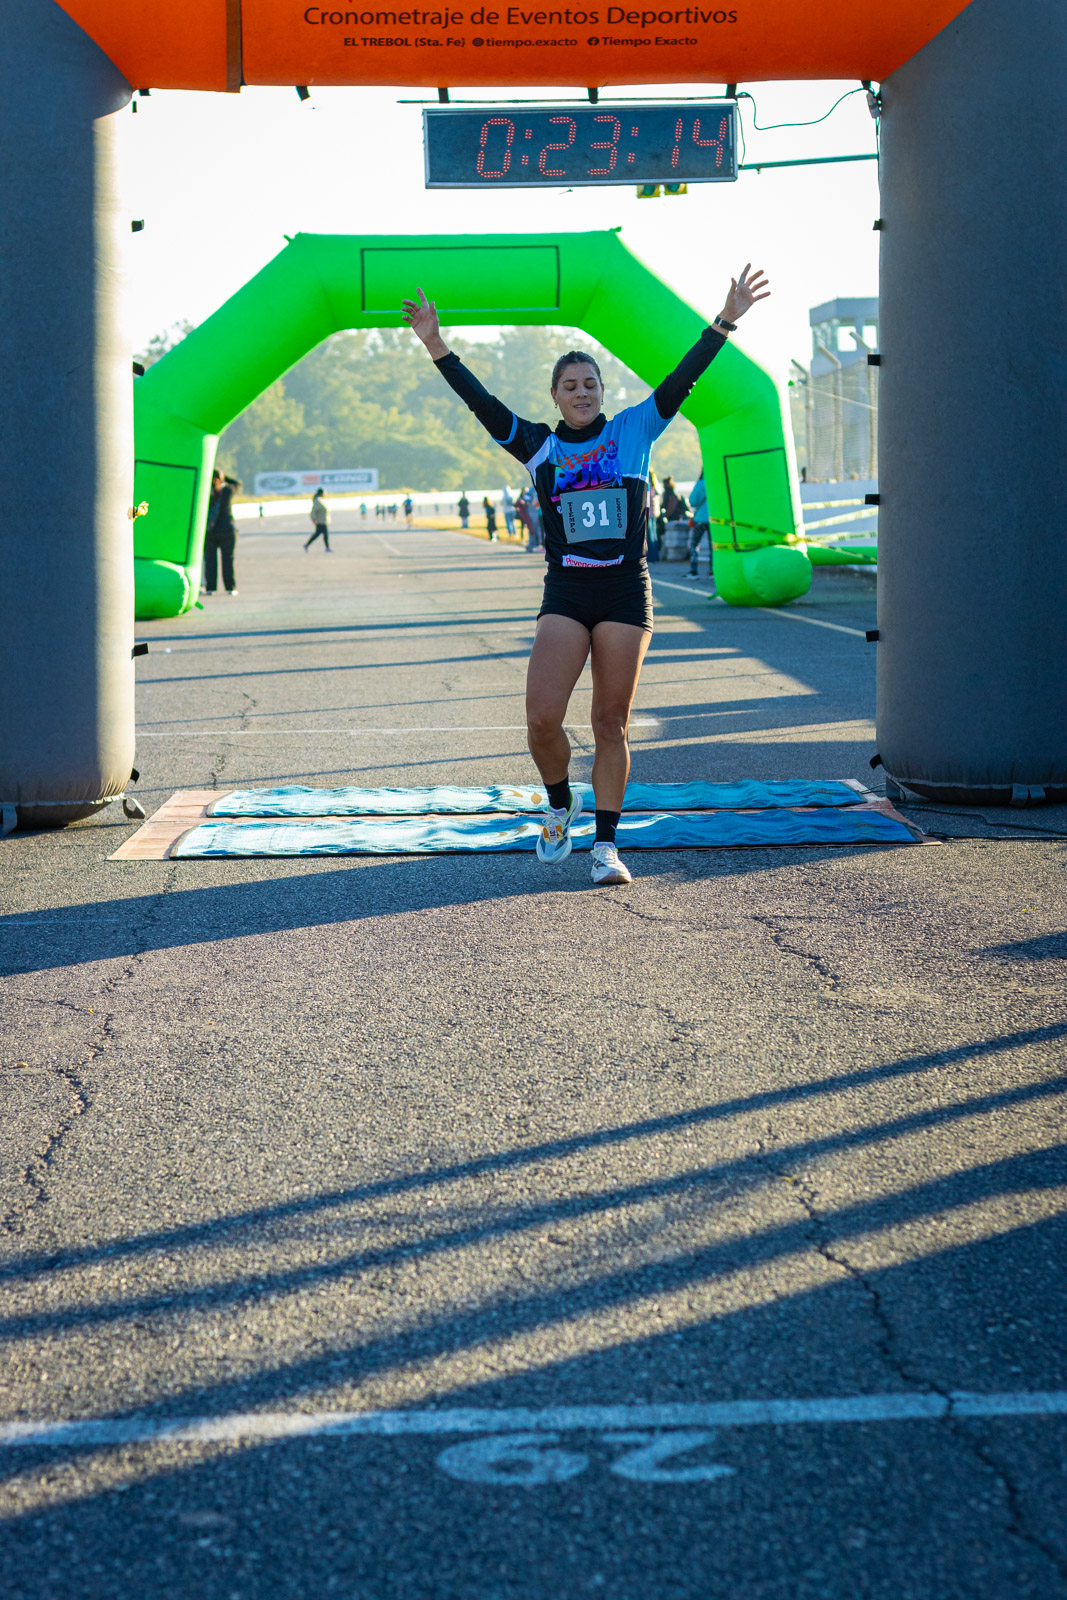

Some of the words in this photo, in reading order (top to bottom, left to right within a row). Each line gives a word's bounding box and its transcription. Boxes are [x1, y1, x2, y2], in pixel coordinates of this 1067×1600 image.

[303, 7, 464, 29] Cronometraje
[470, 6, 500, 25] de
[507, 7, 599, 25] Eventos
[607, 6, 738, 28] Deportivos
[343, 37, 359, 47] EL
[361, 37, 412, 47] TREBOL
[414, 37, 443, 48] (Sta.
[446, 37, 466, 48] Fe)
[486, 37, 578, 48] tiempo.exacto
[602, 36, 651, 48] Tiempo
[655, 36, 698, 46] Exacto
[581, 499, 610, 528] 31
